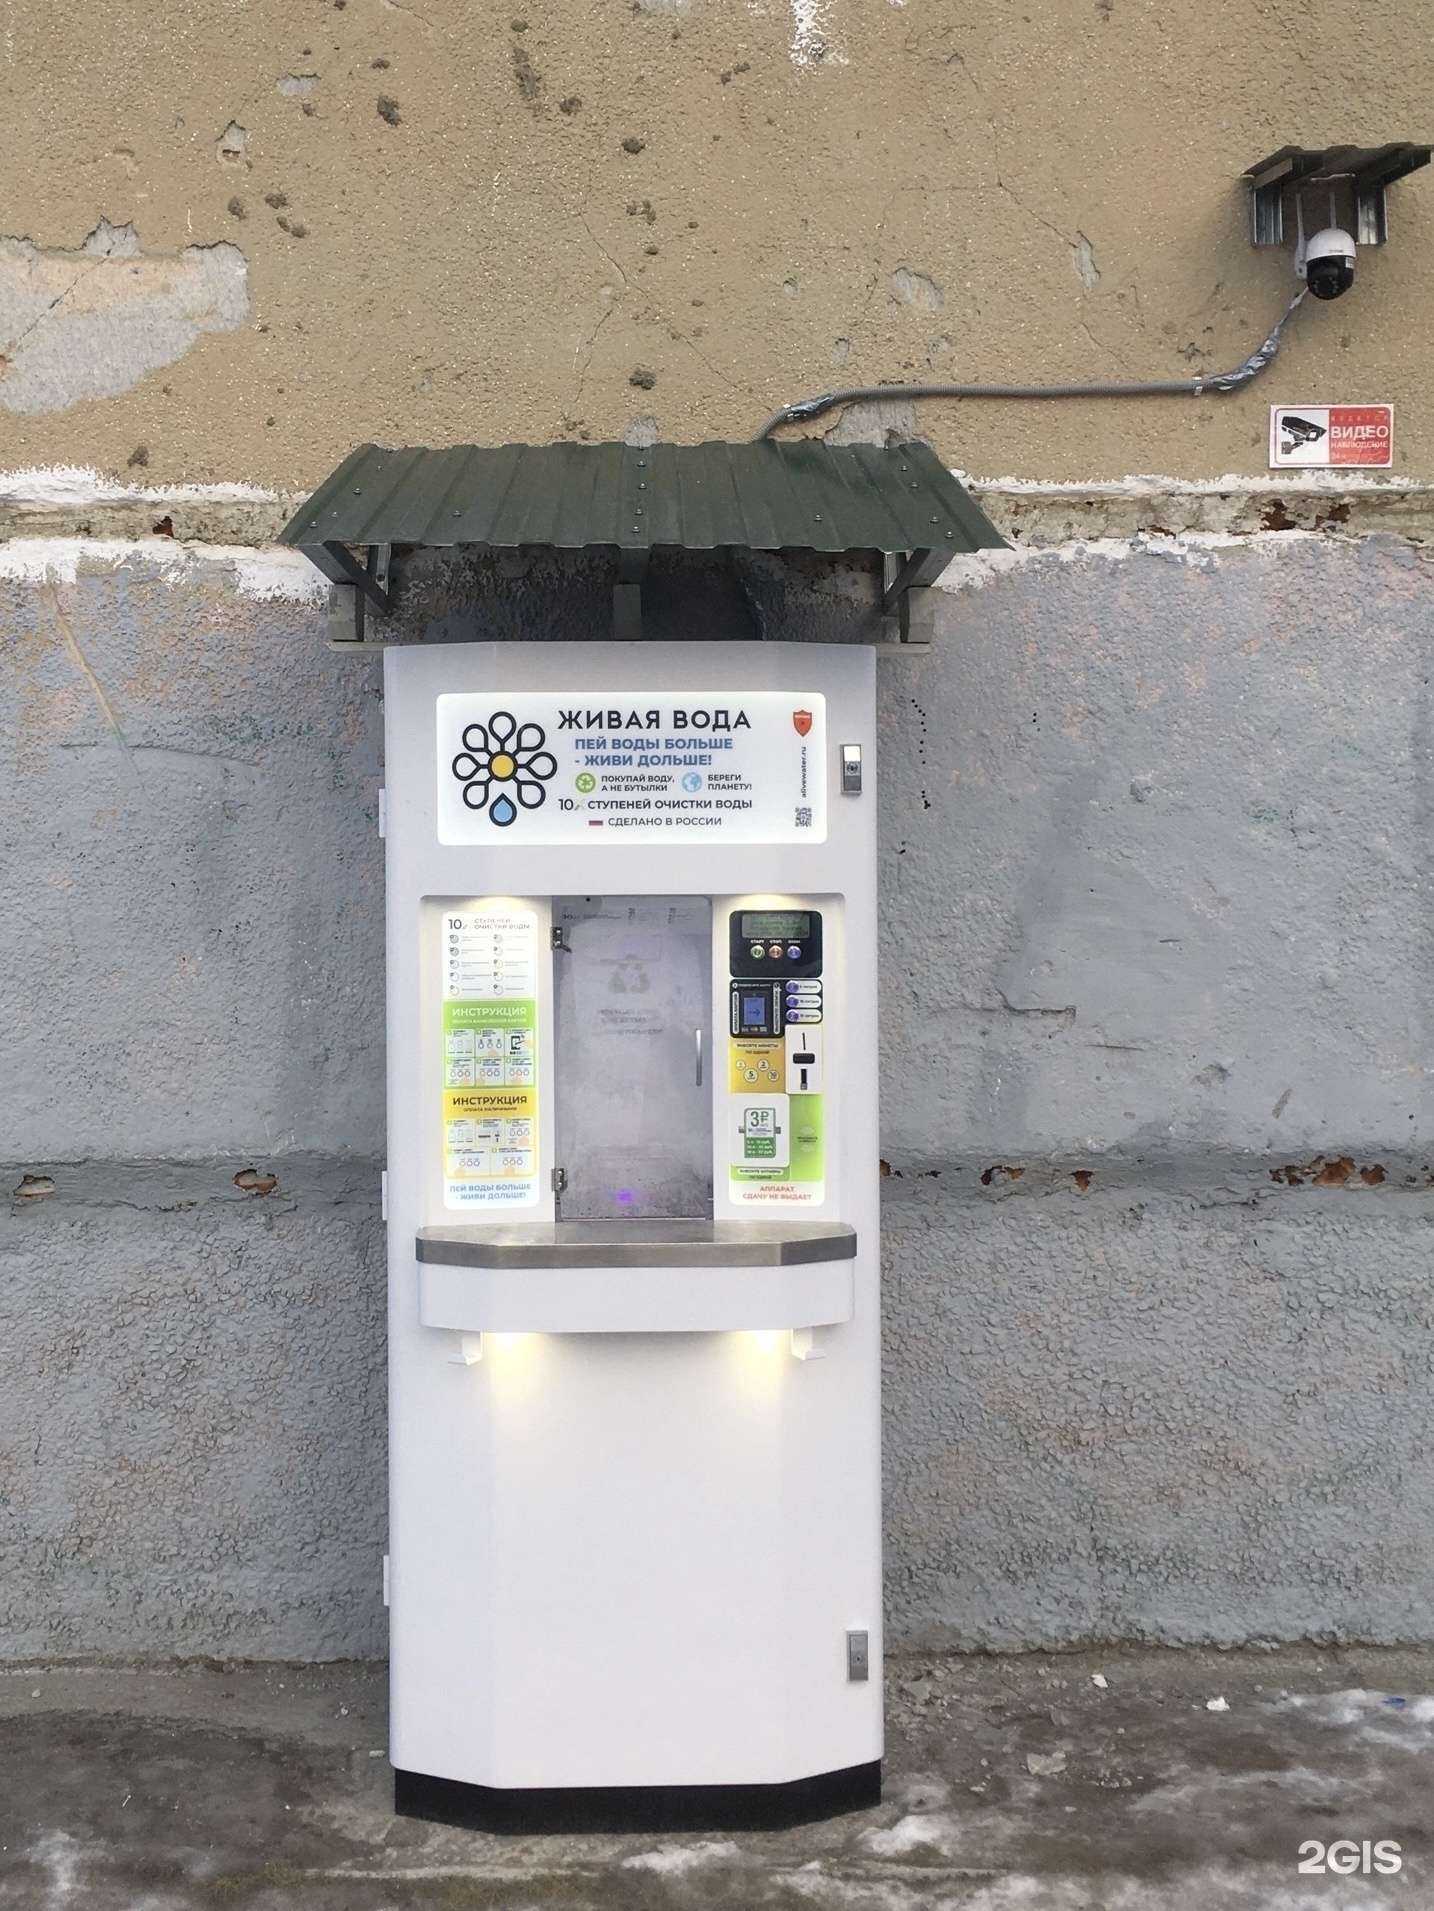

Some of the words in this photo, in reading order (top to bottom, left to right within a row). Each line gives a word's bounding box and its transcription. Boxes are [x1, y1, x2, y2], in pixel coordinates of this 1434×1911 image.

[1331, 425, 1389, 442] ВИДЕО
[558, 709, 660, 729] ЖИВАЯ
[673, 709, 751, 732] ВОДА
[575, 736, 607, 749] ПЕЙ
[612, 738, 659, 751] ВОДЫ
[665, 738, 733, 750] БОЛЬШЕ
[584, 754, 633, 766] ЖИВИ
[638, 754, 712, 768] ДОЛЬШЕ!
[602, 774, 646, 783] ПОКУПАЙ
[648, 775, 675, 783] ВОДУ,
[708, 774, 741, 782] БЕРЕГИ
[624, 784, 668, 792] БУТЫЛКИ
[708, 783, 752, 791] ПЛАНЕТУ!
[558, 799, 574, 811] 10
[587, 798, 651, 810] СТУПЕНЕЙ
[655, 799, 712, 810] ОЧИСТКИ
[716, 799, 752, 810] ВОДЫ
[608, 817, 663, 827] СДЕЛАНО
[665, 818, 673, 826] В
[676, 817, 722, 826] РОССИИ
[448, 918, 462, 930] 10
[452, 1006, 527, 1018] ИНСТРУКЦИЯ
[453, 1095, 528, 1106] ИНСТРУКЦИЯ
